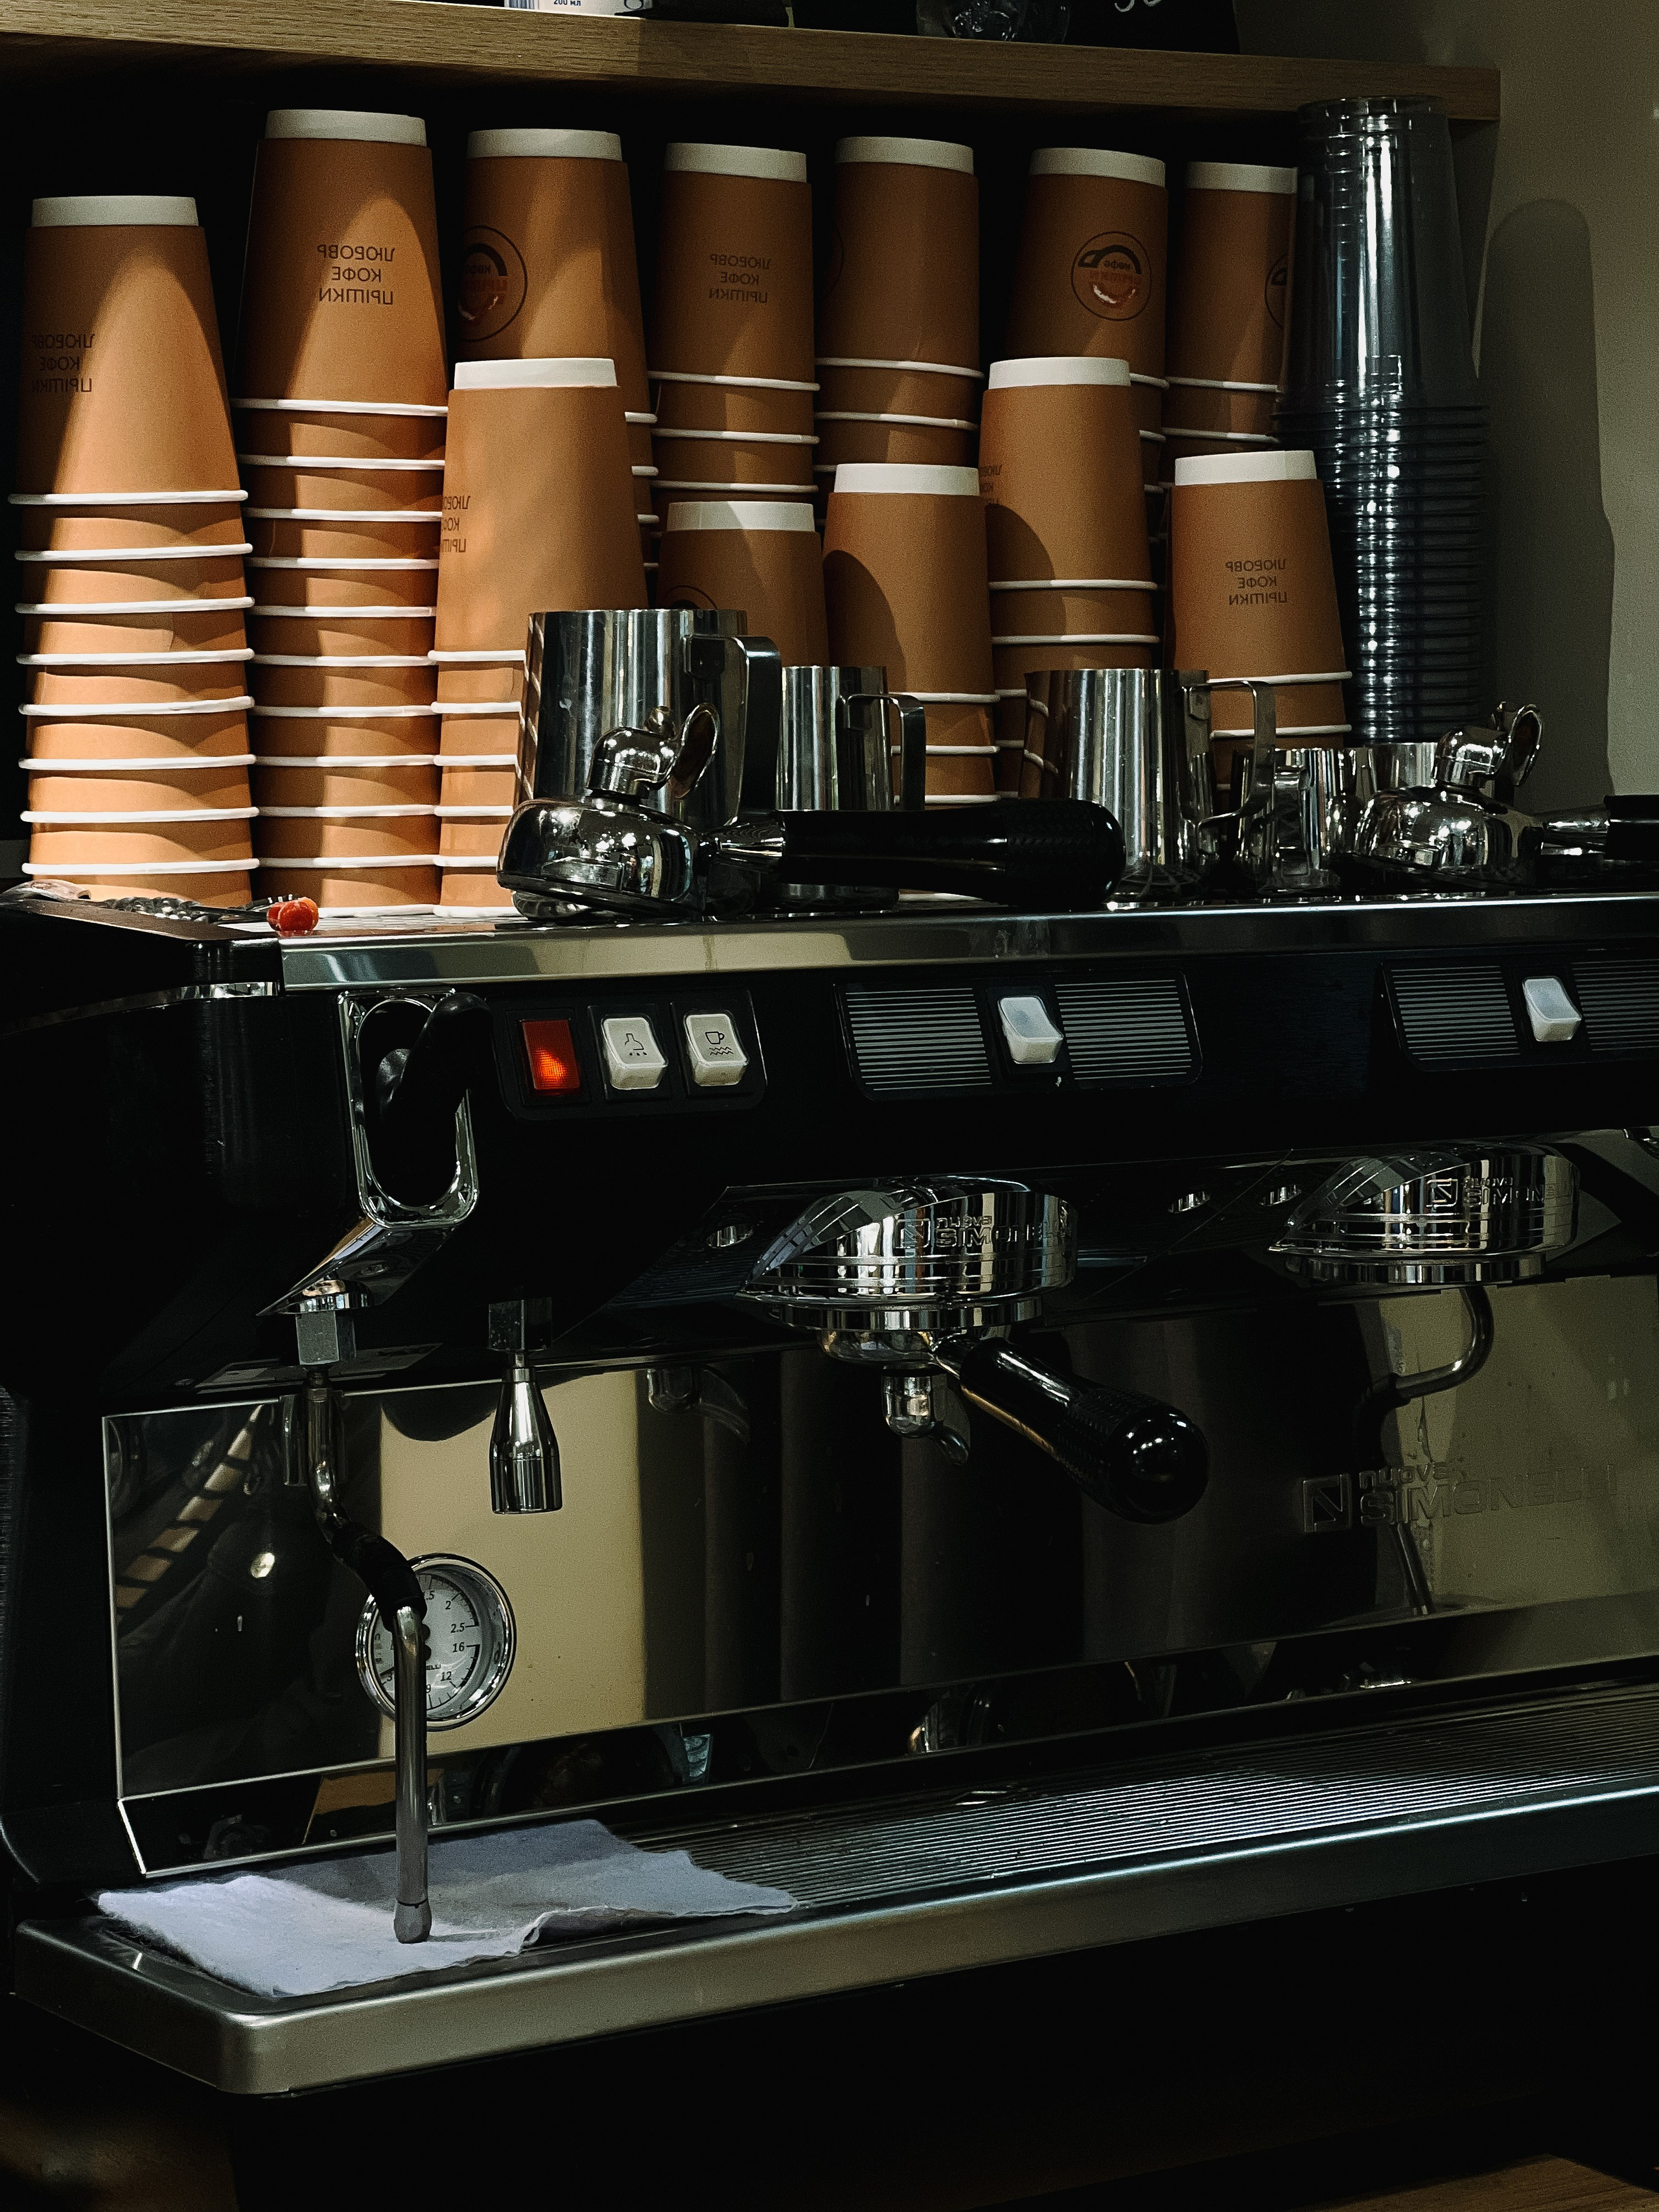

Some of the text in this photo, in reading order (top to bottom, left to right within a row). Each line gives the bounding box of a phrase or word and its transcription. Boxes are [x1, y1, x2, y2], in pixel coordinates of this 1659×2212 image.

[317, 244, 395, 262] ЛЮБОВЬ
[710, 253, 772, 270] ЛЮБОВЬ
[331, 266, 381, 283] КОФЕ
[721, 271, 760, 286] КОФЕ
[319, 288, 393, 305] ПЫШКИ
[709, 288, 769, 303] ПЫШКИ
[1225, 558, 1287, 572] ЛЮБОВЬ
[1237, 576, 1277, 589] КОФЕ
[1229, 591, 1288, 605] ПЫШКИ
[445, 1600, 452, 1610] 2
[451, 1622, 465, 1633] 2.5
[452, 1642, 465, 1653] 16
[441, 1671, 452, 1681] 12
